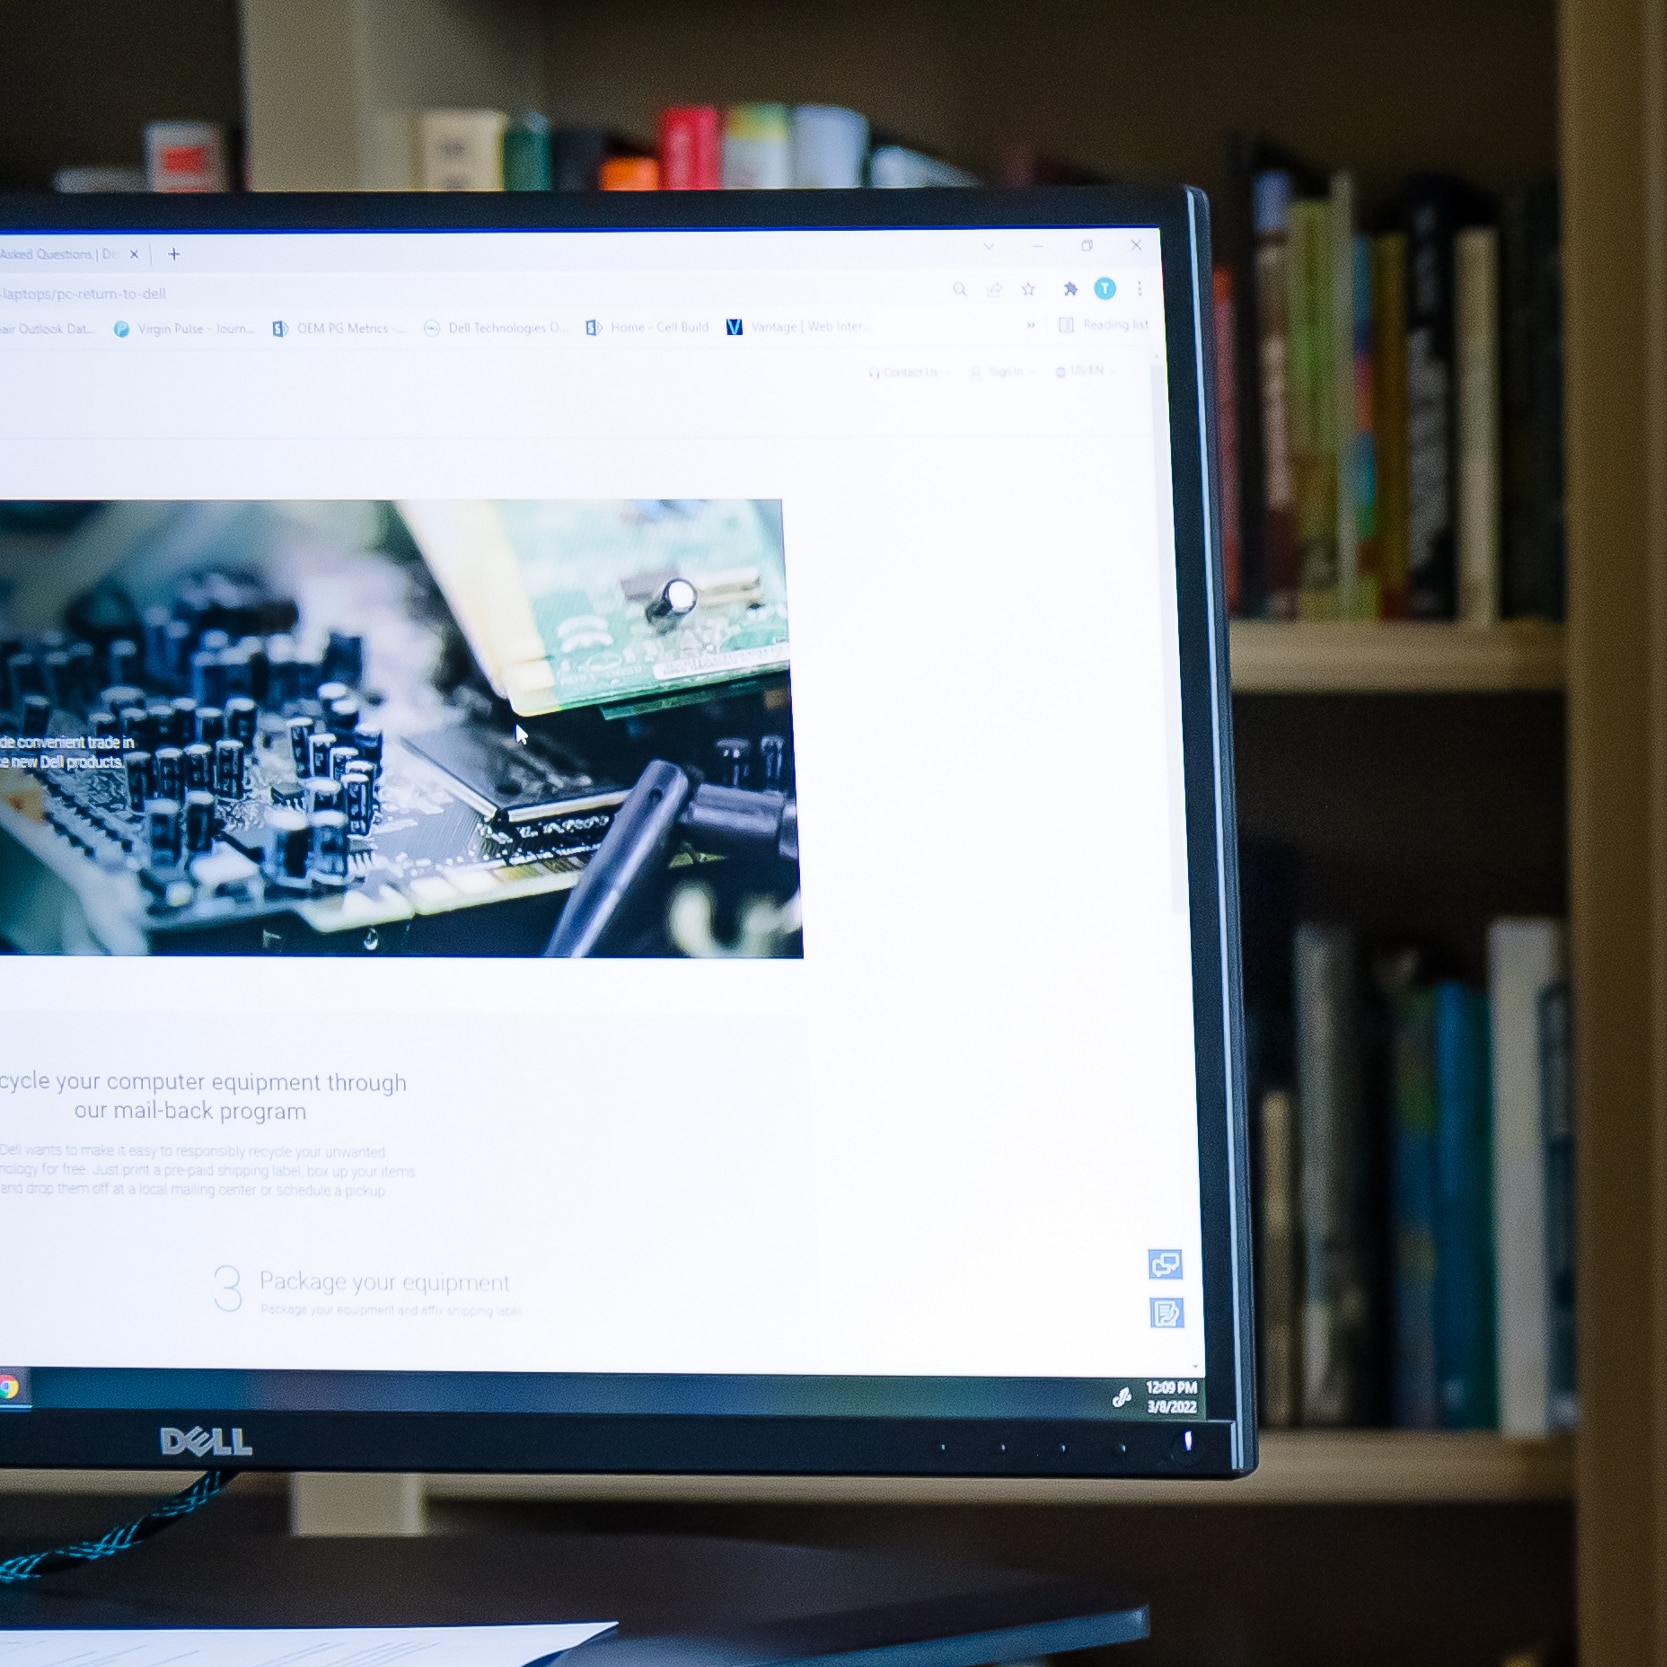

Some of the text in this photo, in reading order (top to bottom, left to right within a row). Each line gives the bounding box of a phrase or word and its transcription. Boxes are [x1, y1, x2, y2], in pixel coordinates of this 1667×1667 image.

[37, 248, 93, 260] Questions
[137, 323, 172, 338] Virgin
[175, 322, 204, 334] Pulse
[297, 322, 325, 334] OEM
[329, 322, 345, 334] PG
[348, 322, 389, 334] Metrics
[448, 321, 471, 334] Dell
[474, 321, 547, 337] Technologies
[611, 321, 646, 333] Home
[656, 320, 678, 333] Cell
[681, 321, 710, 333] Build
[751, 321, 797, 336] Vantage
[807, 320, 834, 332] Web
[1083, 318, 1150, 334] Reading list
[884, 367, 923, 377] Contact
[17, 735, 85, 749] convenient
[87, 735, 121, 749] trade
[122, 735, 136, 749] in
[12, 757, 39, 769] new
[40, 754, 65, 769] Dell
[66, 754, 126, 771] products.
[56, 1075, 101, 1096] your
[107, 1074, 205, 1095] computer
[212, 1073, 321, 1095] equipment
[328, 1073, 407, 1096] through
[74, 1100, 307, 1125] our mail-back program
[25, 1145, 63, 1156] wants
[65, 1145, 78, 1156] to
[81, 1145, 115, 1156] make
[129, 1146, 157, 1160] easy
[160, 1145, 173, 1157] to
[176, 1145, 246, 1161] responsibly
[248, 1145, 293, 1161] recycle
[296, 1147, 321, 1162] your
[325, 1146, 386, 1159] unwanted
[42, 1162, 59, 1175] for
[92, 1164, 120, 1176] Just
[122, 1164, 150, 1179] print
[153, 1166, 161, 1176] a
[164, 1164, 214, 1179] pre-paid
[217, 1165, 269, 1180] shipping
[307, 1165, 329, 1178] box
[332, 1167, 349, 1181] up
[351, 1167, 378, 1181] your
[381, 1166, 417, 1178] items
[127, 1186, 137, 1196] a
[139, 1183, 168, 1196] local
[171, 1184, 216, 1199] mailing
[218, 1185, 257, 1196] center
[260, 1186, 273, 1197] or
[276, 1184, 332, 1198] schedule
[334, 1186, 342, 1197] a
[213, 1264, 243, 1313] 3
[259, 1270, 510, 1297] Package your equipment
[1146, 1380, 1198, 1395] 12:09 PM
[1147, 1399, 1198, 1414] 3/8/2022
[160, 1426, 254, 1458] DELL
